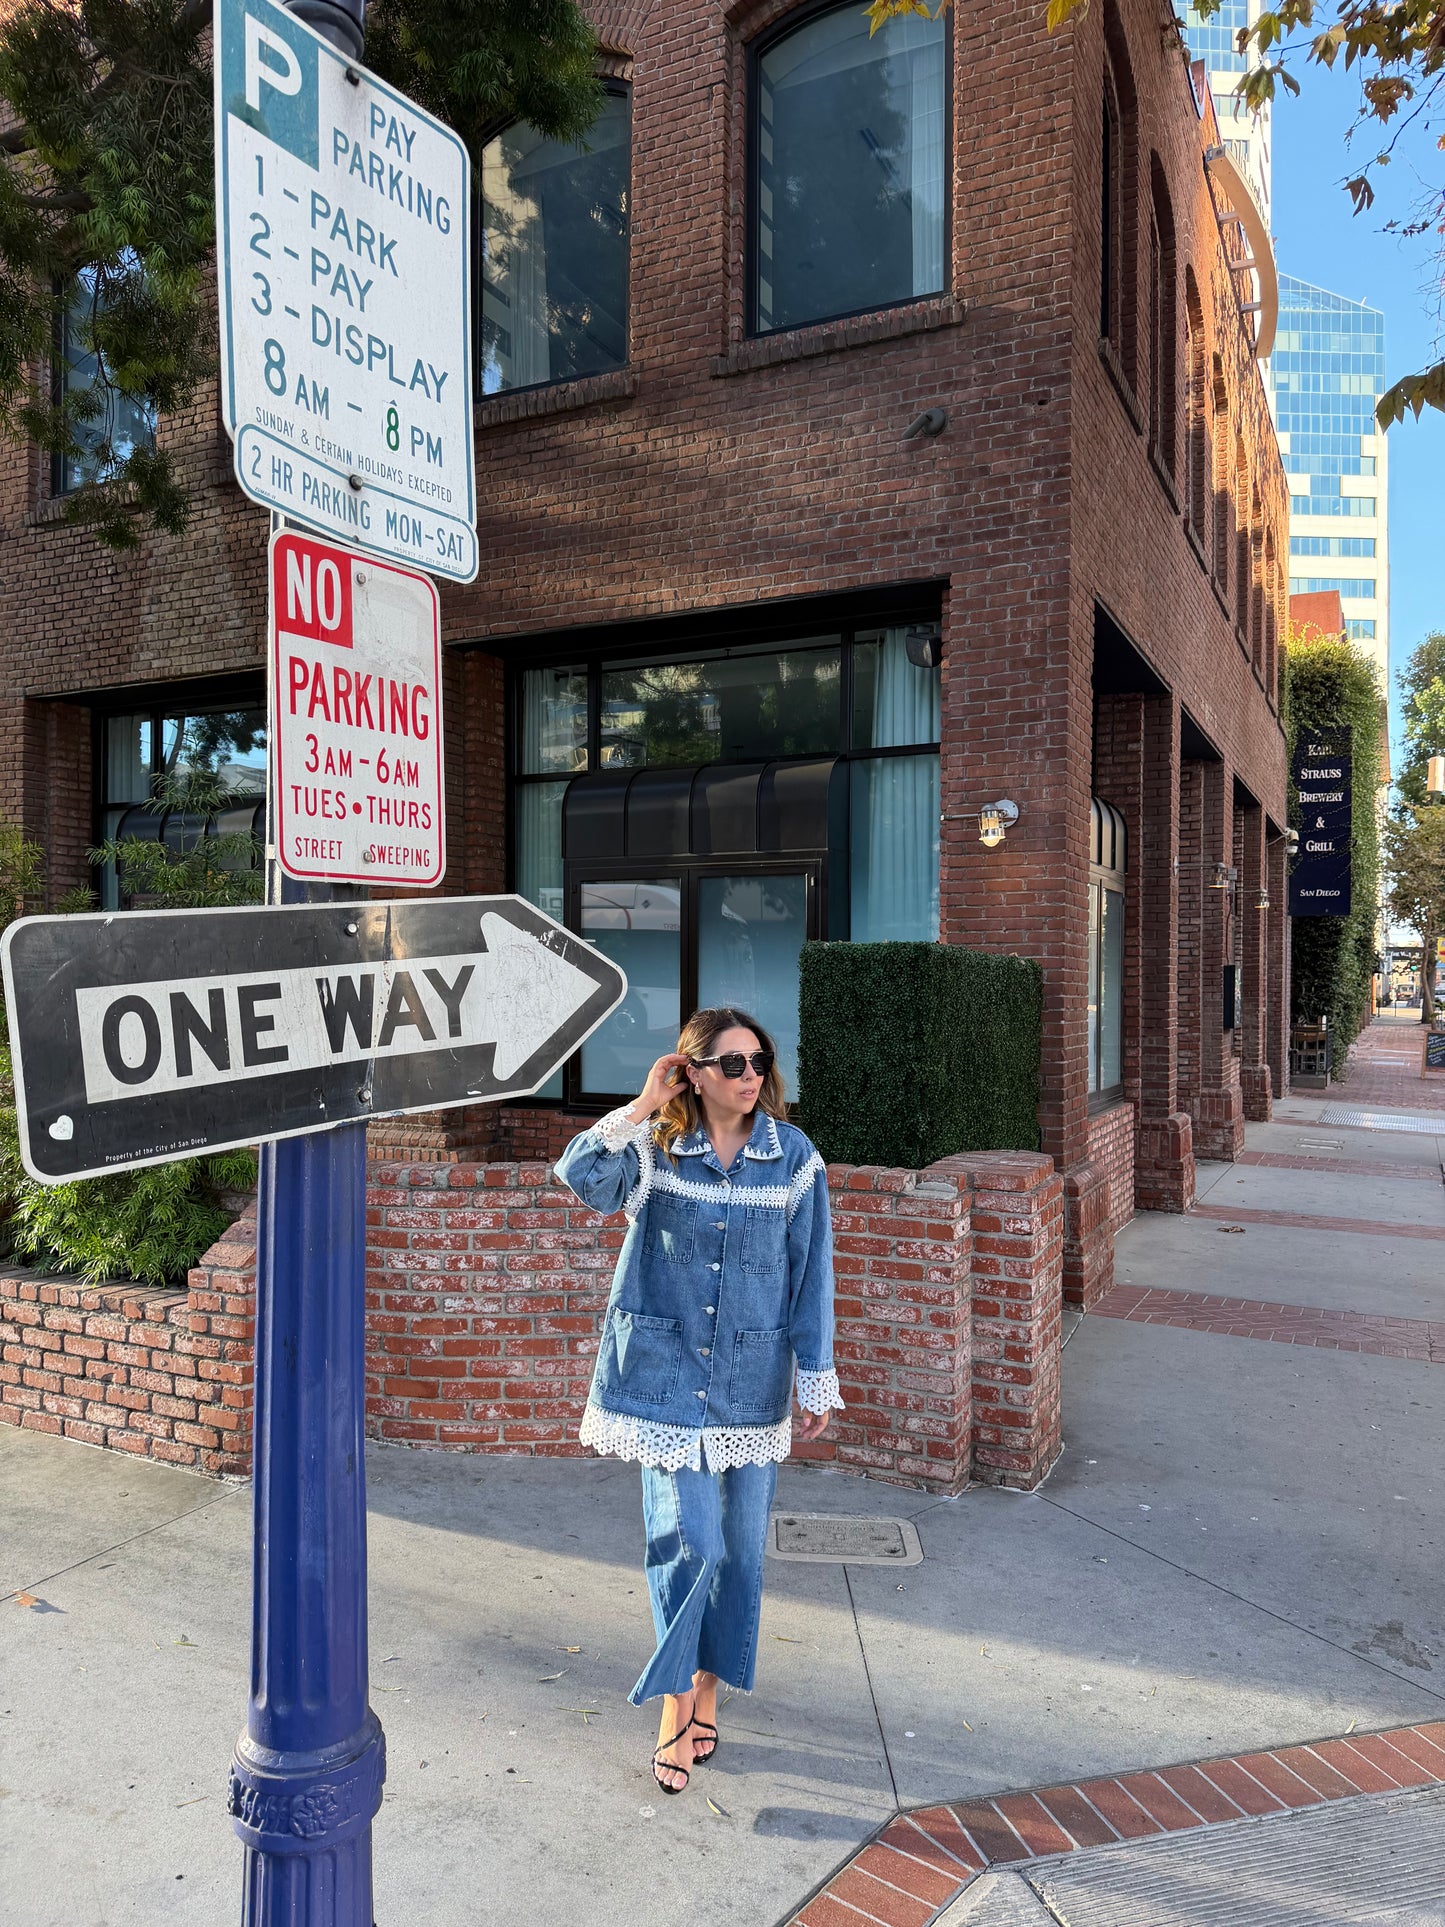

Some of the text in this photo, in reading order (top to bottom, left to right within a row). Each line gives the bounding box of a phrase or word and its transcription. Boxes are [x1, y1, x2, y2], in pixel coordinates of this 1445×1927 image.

[245, 11, 303, 112] P
[370, 101, 417, 164] PAY
[333, 126, 451, 235] PARKING
[251, 444, 262, 479] 2
[271, 454, 293, 495] HR
[302, 471, 371, 530] PARKING
[255, 406, 452, 504] SUNDAY & CERTAIN HOLIDAYS EXCEPTED
[286, 548, 343, 632] NO
[288, 655, 430, 741] PARKING
[295, 836, 430, 868] STREET SWEEPING
[1315, 816, 1325, 829] &
[101, 963, 476, 1086] ONE WAY
[105, 1136, 208, 1163] Property of the City of San Diego
